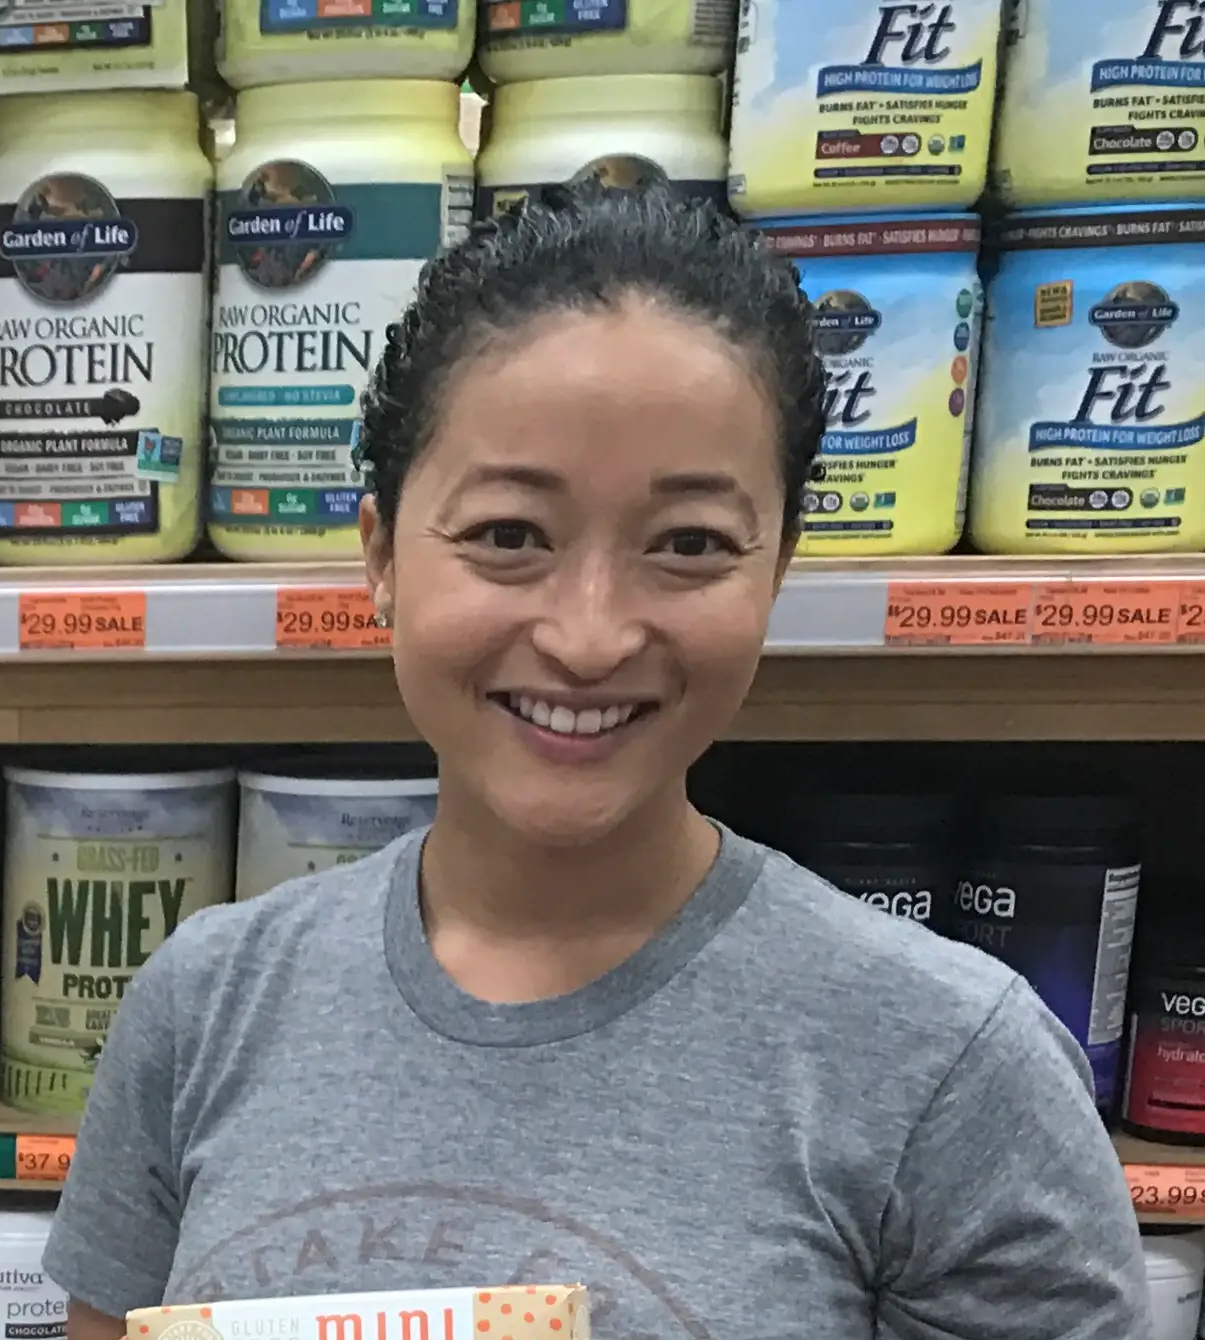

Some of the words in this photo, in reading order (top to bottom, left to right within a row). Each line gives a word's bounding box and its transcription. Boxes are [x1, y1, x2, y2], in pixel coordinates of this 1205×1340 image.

[860, 2, 956, 68] Fit
[824, 72, 852, 87] HIGH
[855, 71, 900, 86] PROTEIN
[1099, 66, 1127, 80] HIGH
[1131, 65, 1178, 79] PROTEIN
[1181, 66, 1201, 80] FOR
[1093, 98, 1129, 108] BURNS
[1128, 110, 1167, 120] FIGHTS
[229, 216, 280, 236] Garden
[308, 211, 345, 232] Life
[3, 229, 67, 248] Garden
[71, 222, 94, 251] of
[95, 225, 129, 244] Life
[219, 305, 247, 328] RAW
[251, 302, 360, 326] ORGANIC
[35, 314, 144, 340] ORGANIC
[213, 330, 373, 374] PROTEIN
[1069, 364, 1172, 425] Fit
[5, 401, 91, 416] CHOCOLATE
[289, 426, 339, 439] FORMULA
[845, 435, 884, 450] WEIGHT
[1035, 428, 1062, 441] HIGH
[1064, 427, 1110, 442] PROTEIN
[1112, 430, 1135, 443] FOR
[1137, 428, 1177, 445] WEIGHT
[46, 437, 78, 452] PLANT
[21, 612, 92, 635] $29.99
[96, 615, 142, 632] SALE
[277, 610, 349, 633] $29.99
[975, 608, 1027, 625] SALE
[1035, 603, 1113, 627] $29.99
[1116, 607, 1172, 625] SALE
[47, 878, 187, 967] WHEY
[62, 972, 129, 999] PROT
[18, 1152, 71, 1172] $37.9
[231, 1317, 300, 1337] GLUTEN
